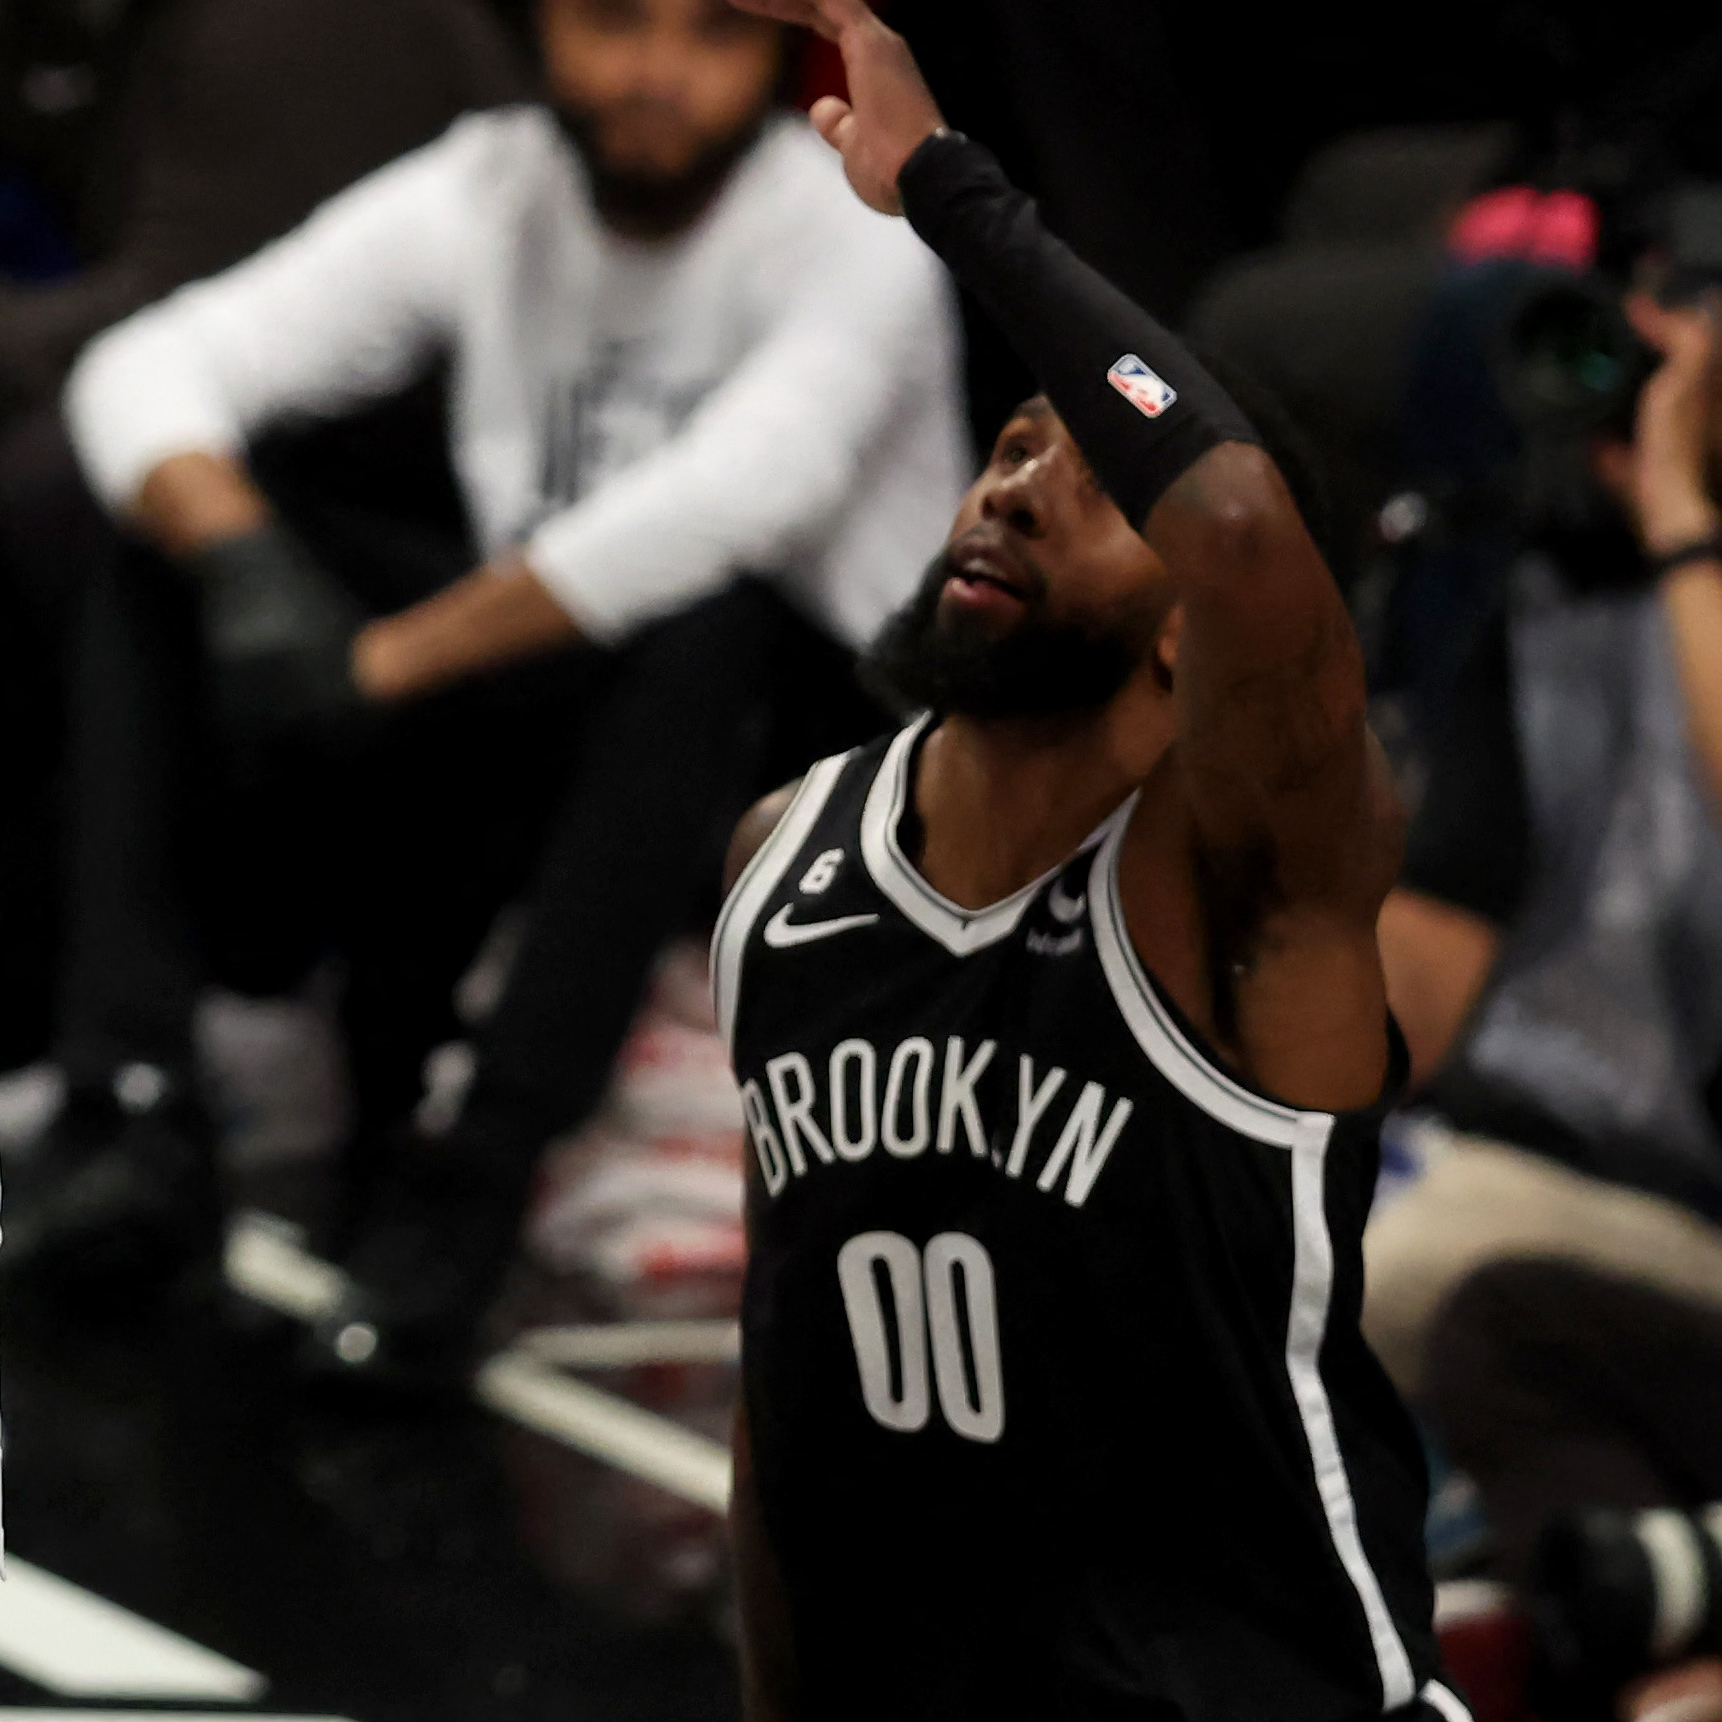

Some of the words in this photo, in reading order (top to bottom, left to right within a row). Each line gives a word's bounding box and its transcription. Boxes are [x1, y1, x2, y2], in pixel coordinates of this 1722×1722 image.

[798, 847, 845, 895] 6
[740, 1034, 1135, 1209] BROOKYN
[836, 1229, 1006, 1445] 00
